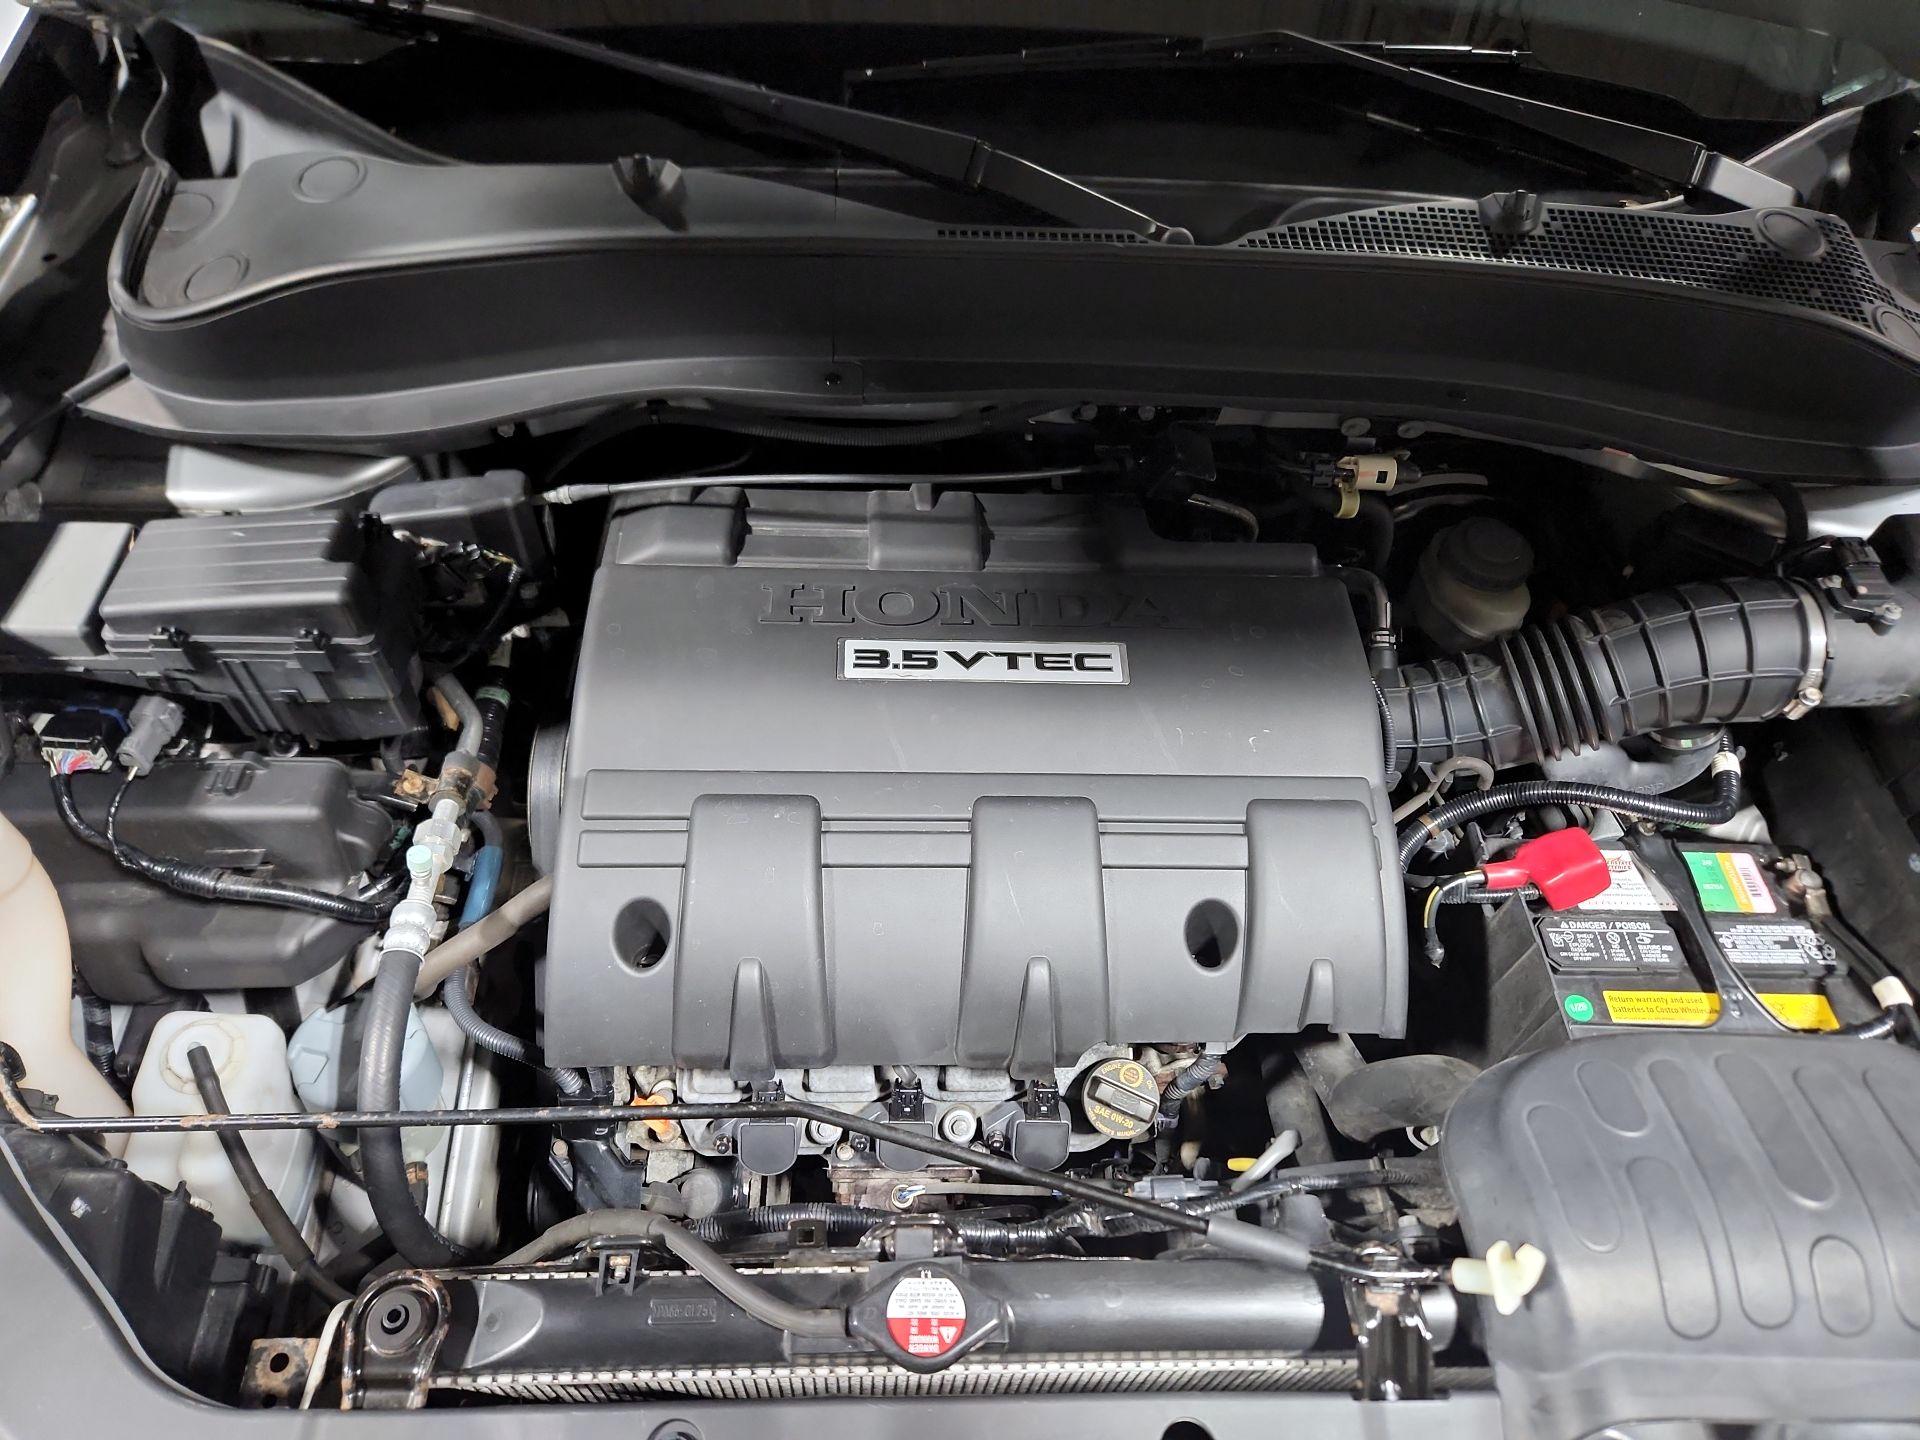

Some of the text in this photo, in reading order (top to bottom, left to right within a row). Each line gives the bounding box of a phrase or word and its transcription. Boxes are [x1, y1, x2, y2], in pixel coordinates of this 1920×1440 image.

[758, 583, 1203, 630] HONDA
[1568, 921, 1607, 930] DANGER
[1615, 921, 1651, 931] POISON
[1608, 995, 1633, 1003] Return
[1634, 996, 1668, 1004] warranty
[1670, 996, 1684, 1004] and
[1611, 1005, 1646, 1013] batteries
[1656, 1005, 1679, 1014] Costco
[1093, 1105, 1134, 1129] SAE 0W-20
